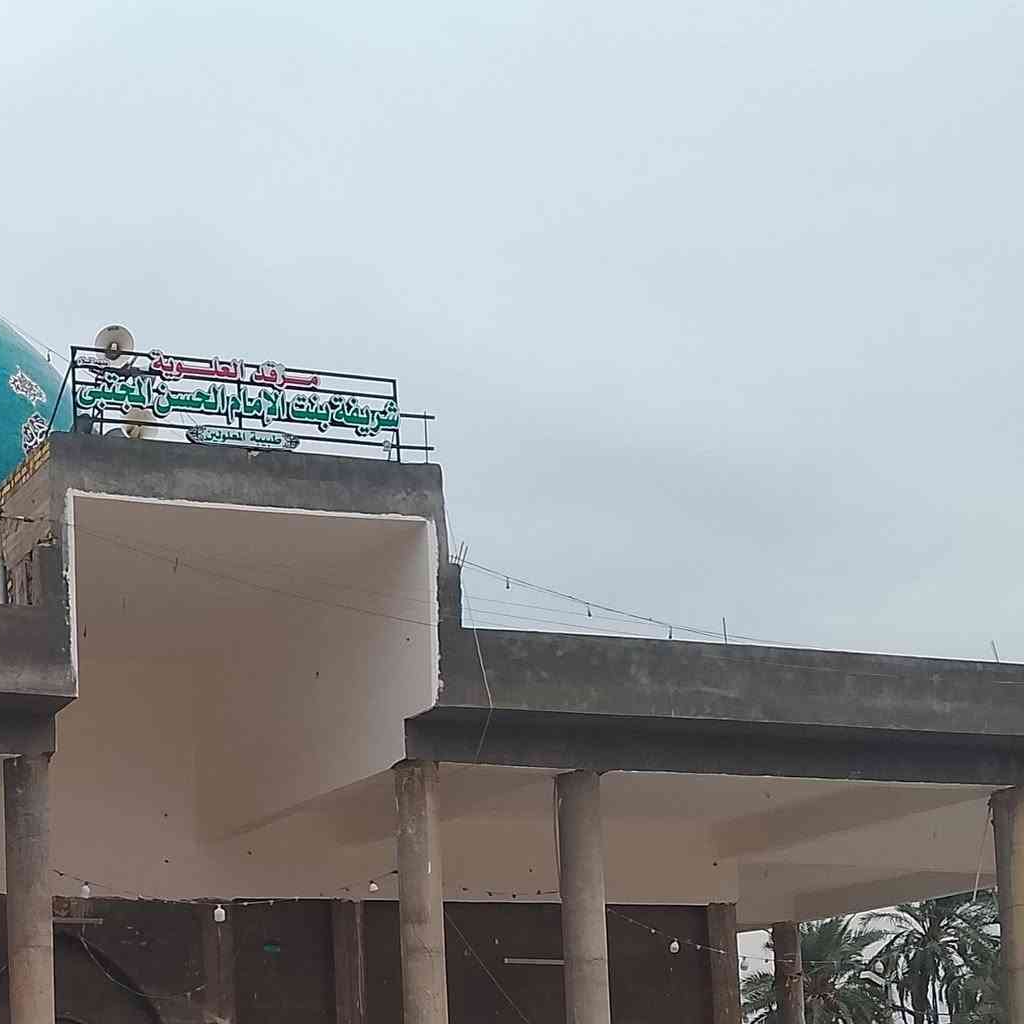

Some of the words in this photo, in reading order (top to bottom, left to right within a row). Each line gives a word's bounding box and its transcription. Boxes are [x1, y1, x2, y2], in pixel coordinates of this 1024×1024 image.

[149, 350, 244, 380] العلوية
[252, 361, 321, 388] مرقد
[77, 373, 152, 413] المجتبى
[154, 382, 227, 416] الحسن
[288, 394, 330, 433] بنت
[329, 396, 400, 436] شريفة
